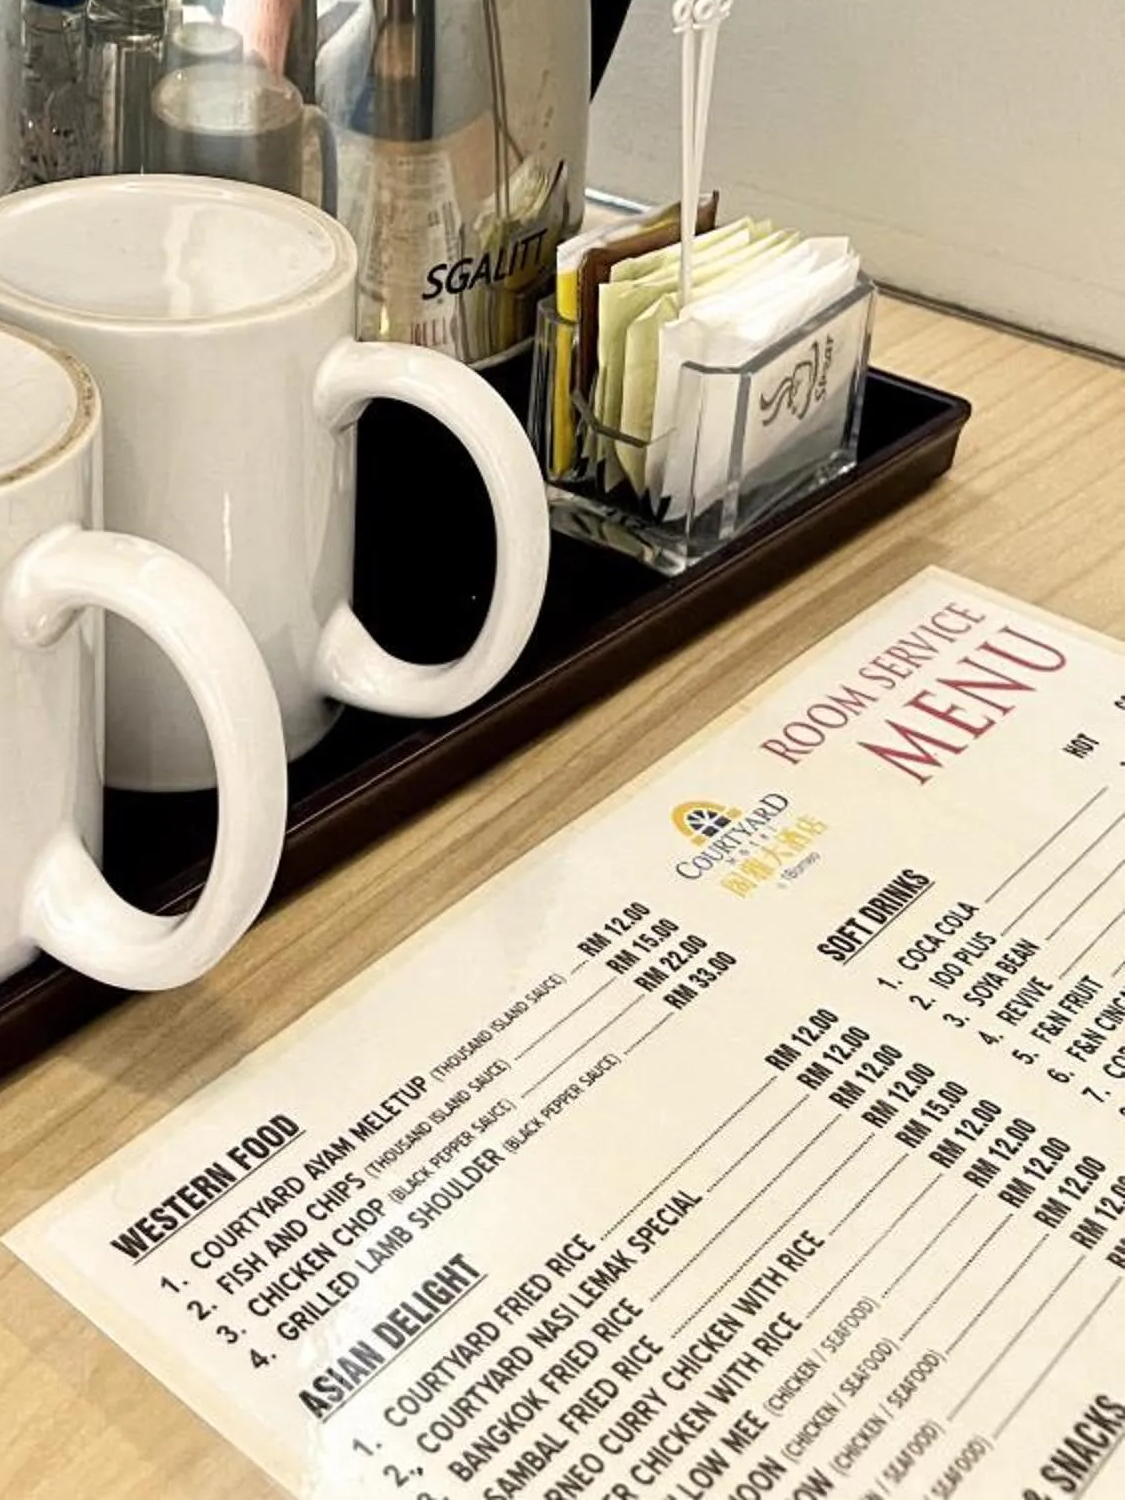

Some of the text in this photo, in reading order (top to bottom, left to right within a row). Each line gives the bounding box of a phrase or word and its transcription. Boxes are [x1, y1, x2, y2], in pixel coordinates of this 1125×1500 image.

[760, 602, 986, 764] ROOM SERVICE
[857, 626, 1067, 785] MENU
[1062, 732, 1099, 759] HOT
[676, 793, 789, 879] COURTYARD
[816, 868, 930, 962] SOFT DRINKS
[876, 901, 980, 990] 1. COCA COLA
[908, 930, 997, 1011] 2. 100 PLUS
[941, 937, 1040, 1028] 3. SOYA BEAN
[977, 975, 1054, 1045] 4. REVIVE
[1010, 974, 1103, 1065] 5. F&N FRUIT
[160, 901, 650, 1293] 1. COURTYARD AYAM MELETUP (THOUSAND ISLAND SAUCE) RM 12.00
[186, 917, 679, 1321] 2. FISH AND CHIPS (THOUSAND ISLAND SAUCE) RM 15.00
[1046, 1067, 1075, 1083] 6.
[1064, 1026, 1107, 1063] F&N
[1080, 1085, 1111, 1103] 7.
[109, 1114, 299, 1259] WESTERN FOOD
[215, 933, 708, 1344] 3. CHICKEN CHOP (BLACK PEPPER SAUCE) RM 22.00
[249, 950, 737, 1368] 4. GRILLED LAMB SHOULDER (BLACK PEPPER SAUCE) RM 33.00
[352, 1008, 839, 1456] 1. COURTYARD FRIED RICE RM 12.00
[416, 1345, 533, 1453] COURTYARD
[525, 1302, 579, 1349] NASI
[568, 1248, 637, 1309] LEMAK
[626, 1189, 703, 1254] SPECIAL
[795, 1060, 834, 1090] RM
[821, 1025, 870, 1065] 12.00
[447, 1043, 903, 1482] BANGKOK FRIED RICE RM 12.00
[557, 1377, 619, 1435] FRIED
[610, 1334, 664, 1382] RICE
[860, 1098, 899, 1129] RM
[887, 1062, 935, 1103] 12.00
[598, 1386, 667, 1455] CURRY
[661, 1311, 744, 1391] CHICKEN
[730, 1266, 789, 1316] WITH
[775, 1229, 825, 1272] RICE
[893, 1117, 932, 1149] RM
[919, 1080, 968, 1122] 15.00
[629, 1098, 1002, 1485] CHICKEN WITH RICE RM 12.00
[719, 1409, 769, 1455] MEE
[762, 1357, 821, 1417] (CHICKEN
[819, 1295, 880, 1354] SEAFOOD)
[962, 1156, 1001, 1189] RM
[987, 1117, 1036, 1161] 12.00
[780, 1401, 840, 1463] (CHICKEN
[838, 1337, 900, 1397] SEAFOOD)
[996, 1176, 1036, 1208] RM
[1021, 1136, 1071, 1180] 12.00
[885, 1348, 946, 1409] SEAFOOD)
[1032, 1196, 1072, 1229] RM
[1057, 1155, 1106, 1201] 12.00
[1068, 1216, 1108, 1250] RM
[297, 1252, 480, 1419] ASIAN DELIGHT
[1039, 1394, 1125, 1493] SNACKS
